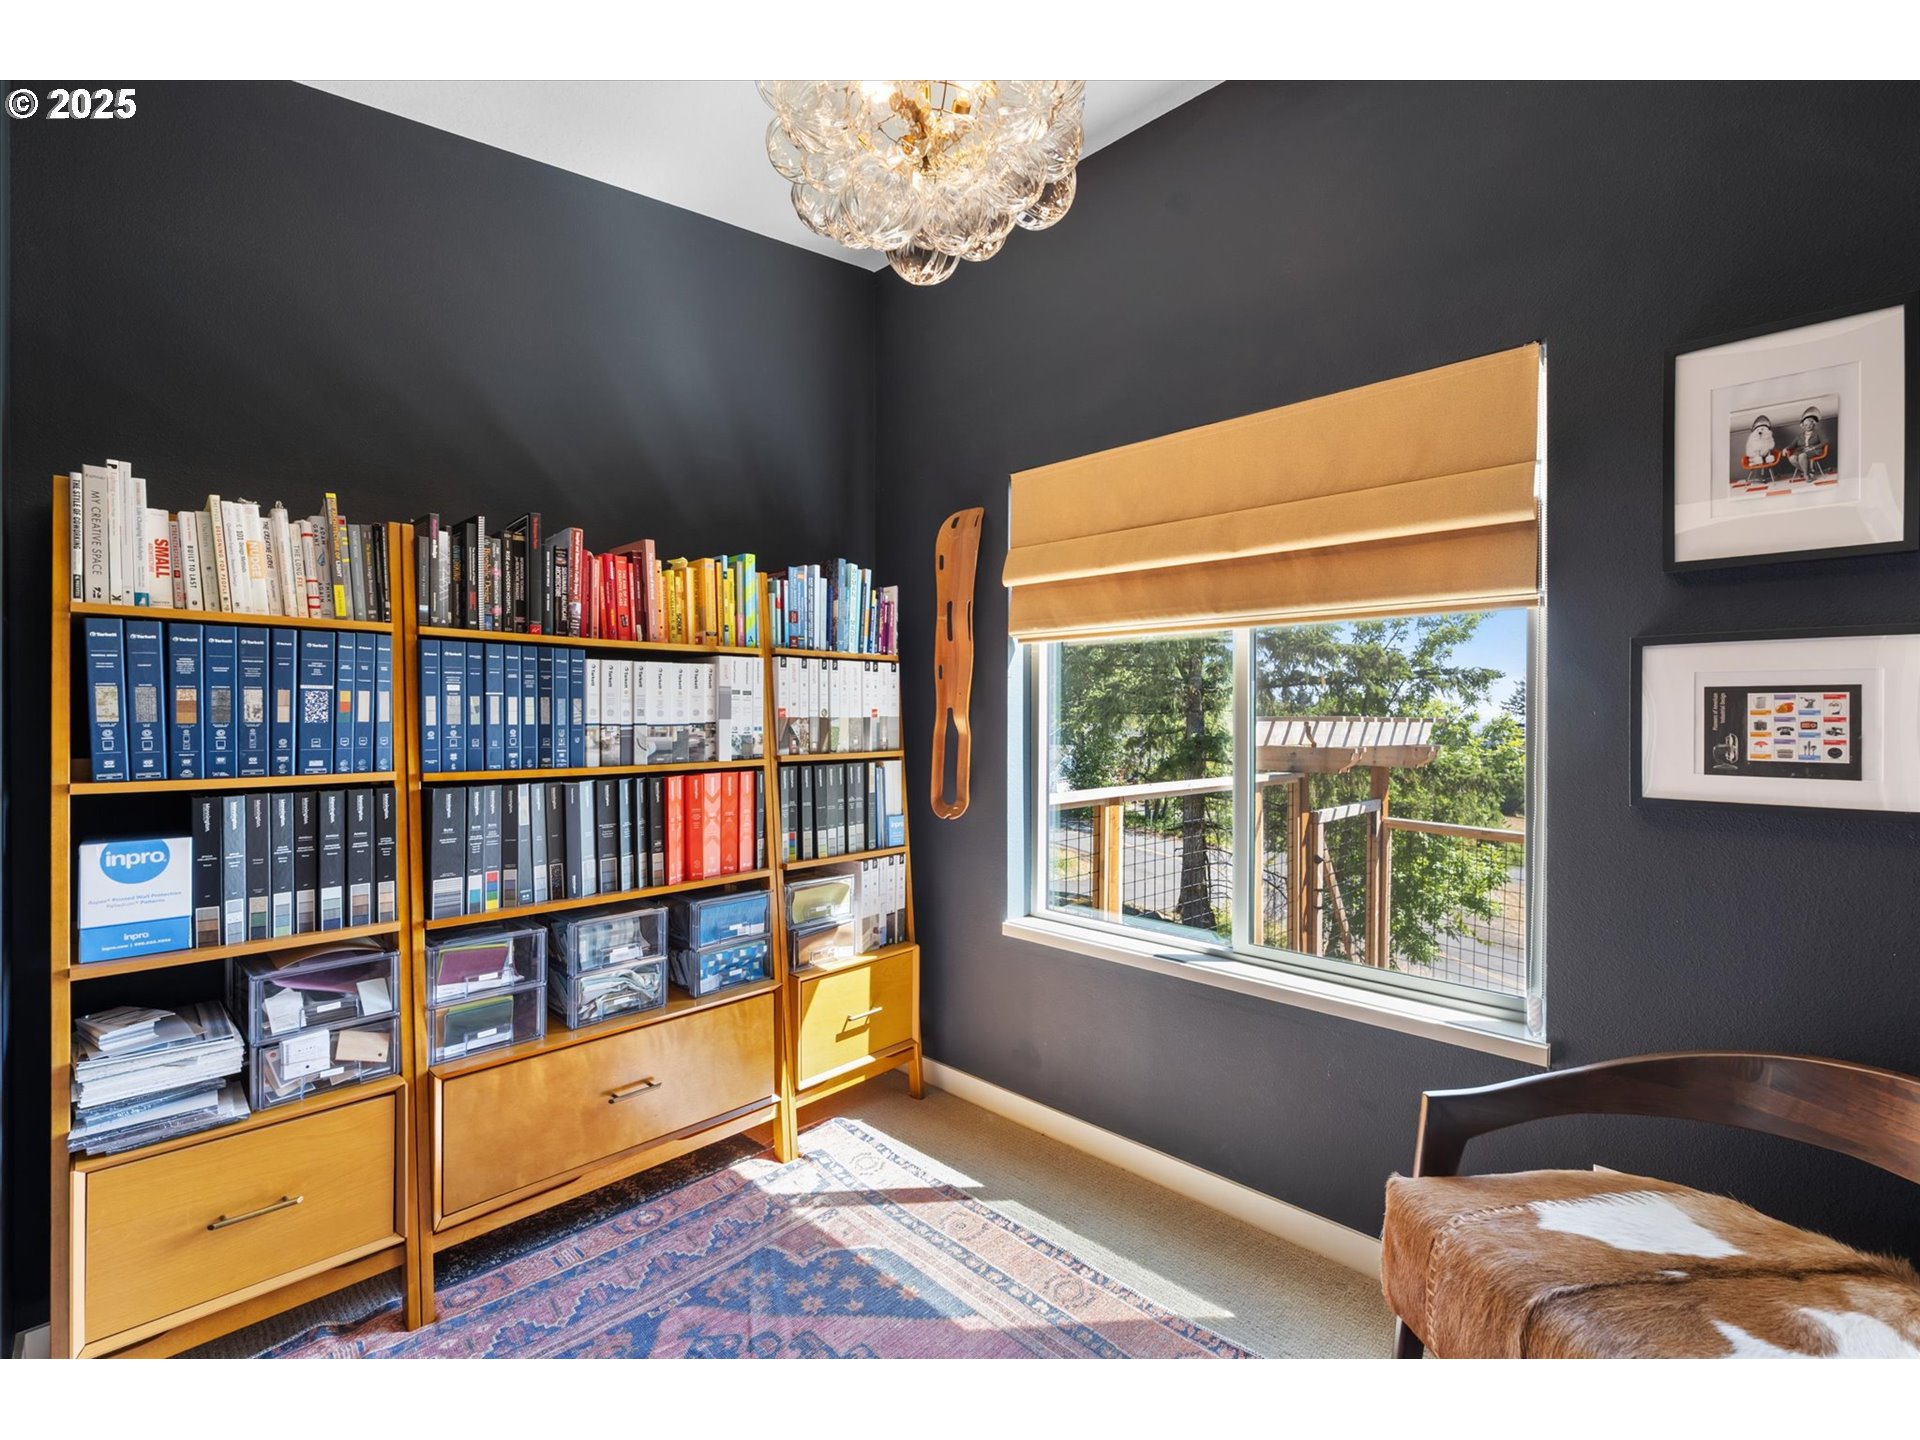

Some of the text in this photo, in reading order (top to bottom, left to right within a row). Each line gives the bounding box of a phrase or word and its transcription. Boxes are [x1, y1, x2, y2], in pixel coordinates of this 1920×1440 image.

[72, 479, 81, 490] THE
[72, 491, 81, 508] STYLE
[73, 508, 82, 517] OF
[73, 517, 82, 550] COWORKING
[91, 490, 103, 575] MY CREATIVE SPACE
[236, 530, 244, 541] 101
[263, 530, 272, 553] CREATIVE
[154, 539, 170, 578] SMALL
[187, 545, 196, 562] BUILT
[215, 525, 225, 558] DESIGNING
[220, 574, 228, 595] PEOPLE
[188, 564, 197, 572] TO
[295, 559, 303, 576] LONG
[189, 573, 197, 589] LAST
[105, 851, 165, 869] inpro
[123, 932, 150, 941] inpro
